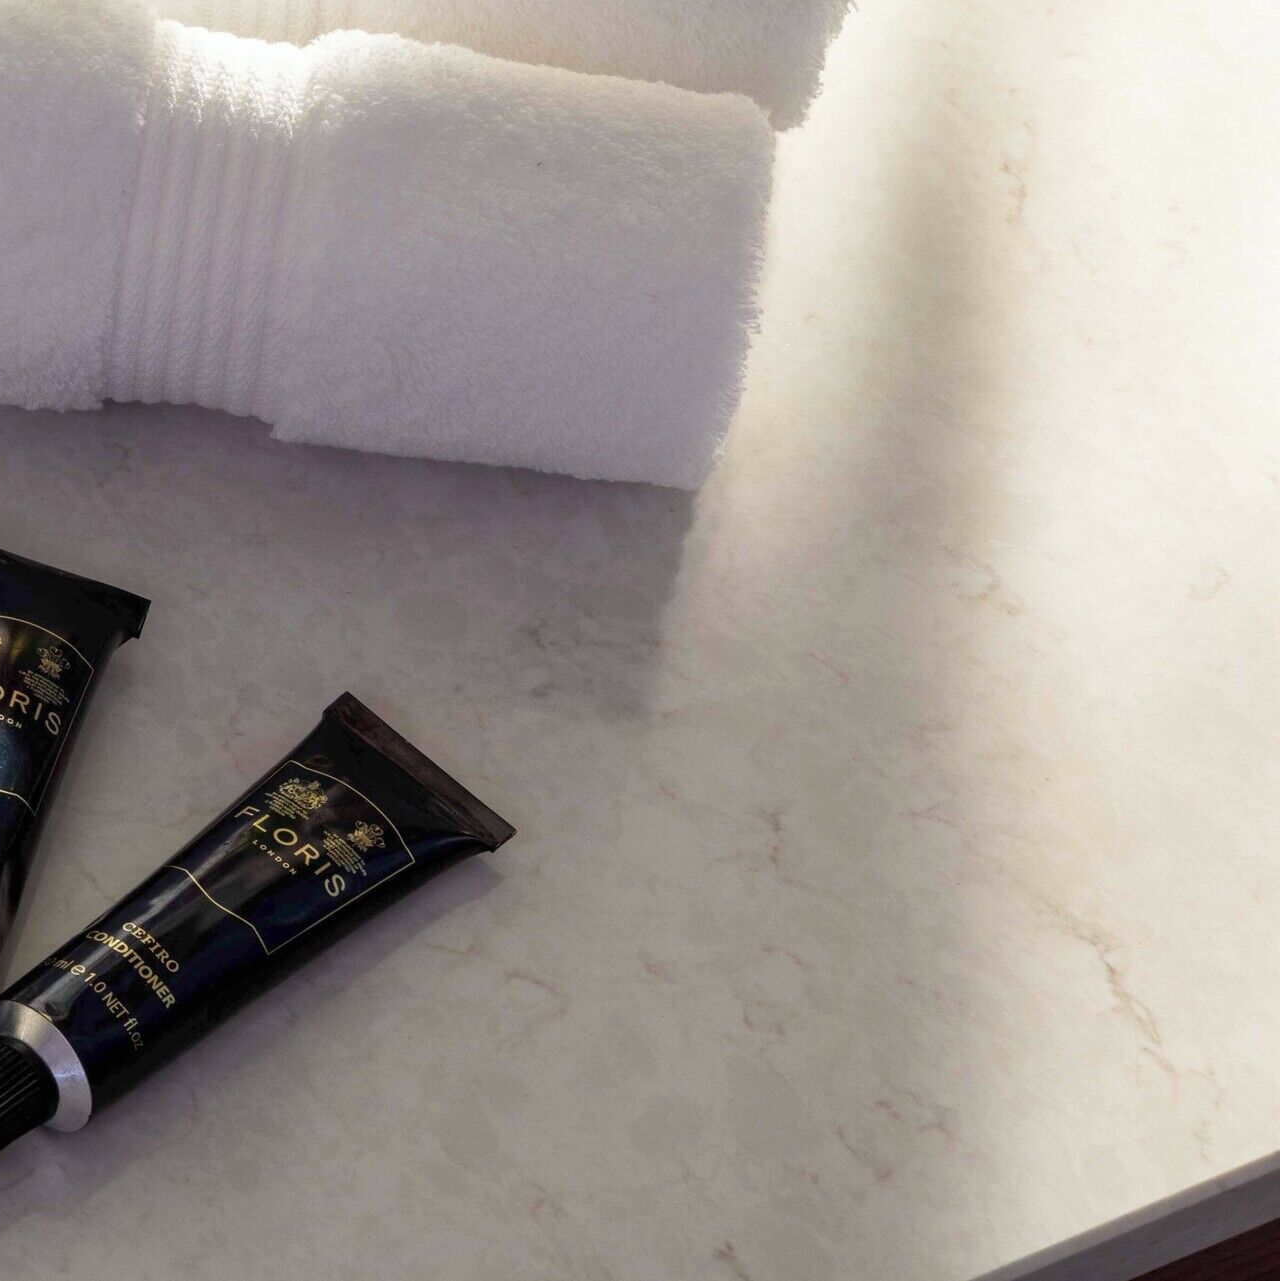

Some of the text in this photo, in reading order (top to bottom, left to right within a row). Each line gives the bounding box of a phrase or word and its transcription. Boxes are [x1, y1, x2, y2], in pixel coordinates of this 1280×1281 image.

[234, 805, 346, 897] FLORIS
[252, 839, 297, 876] LONDON
[85, 930, 177, 1009] CONDITIONER
[122, 922, 180, 973] CEFIRO
[84, 972, 107, 994] 1.0
[101, 991, 130, 1019] NET
[123, 1017, 144, 1051] fl.oz
